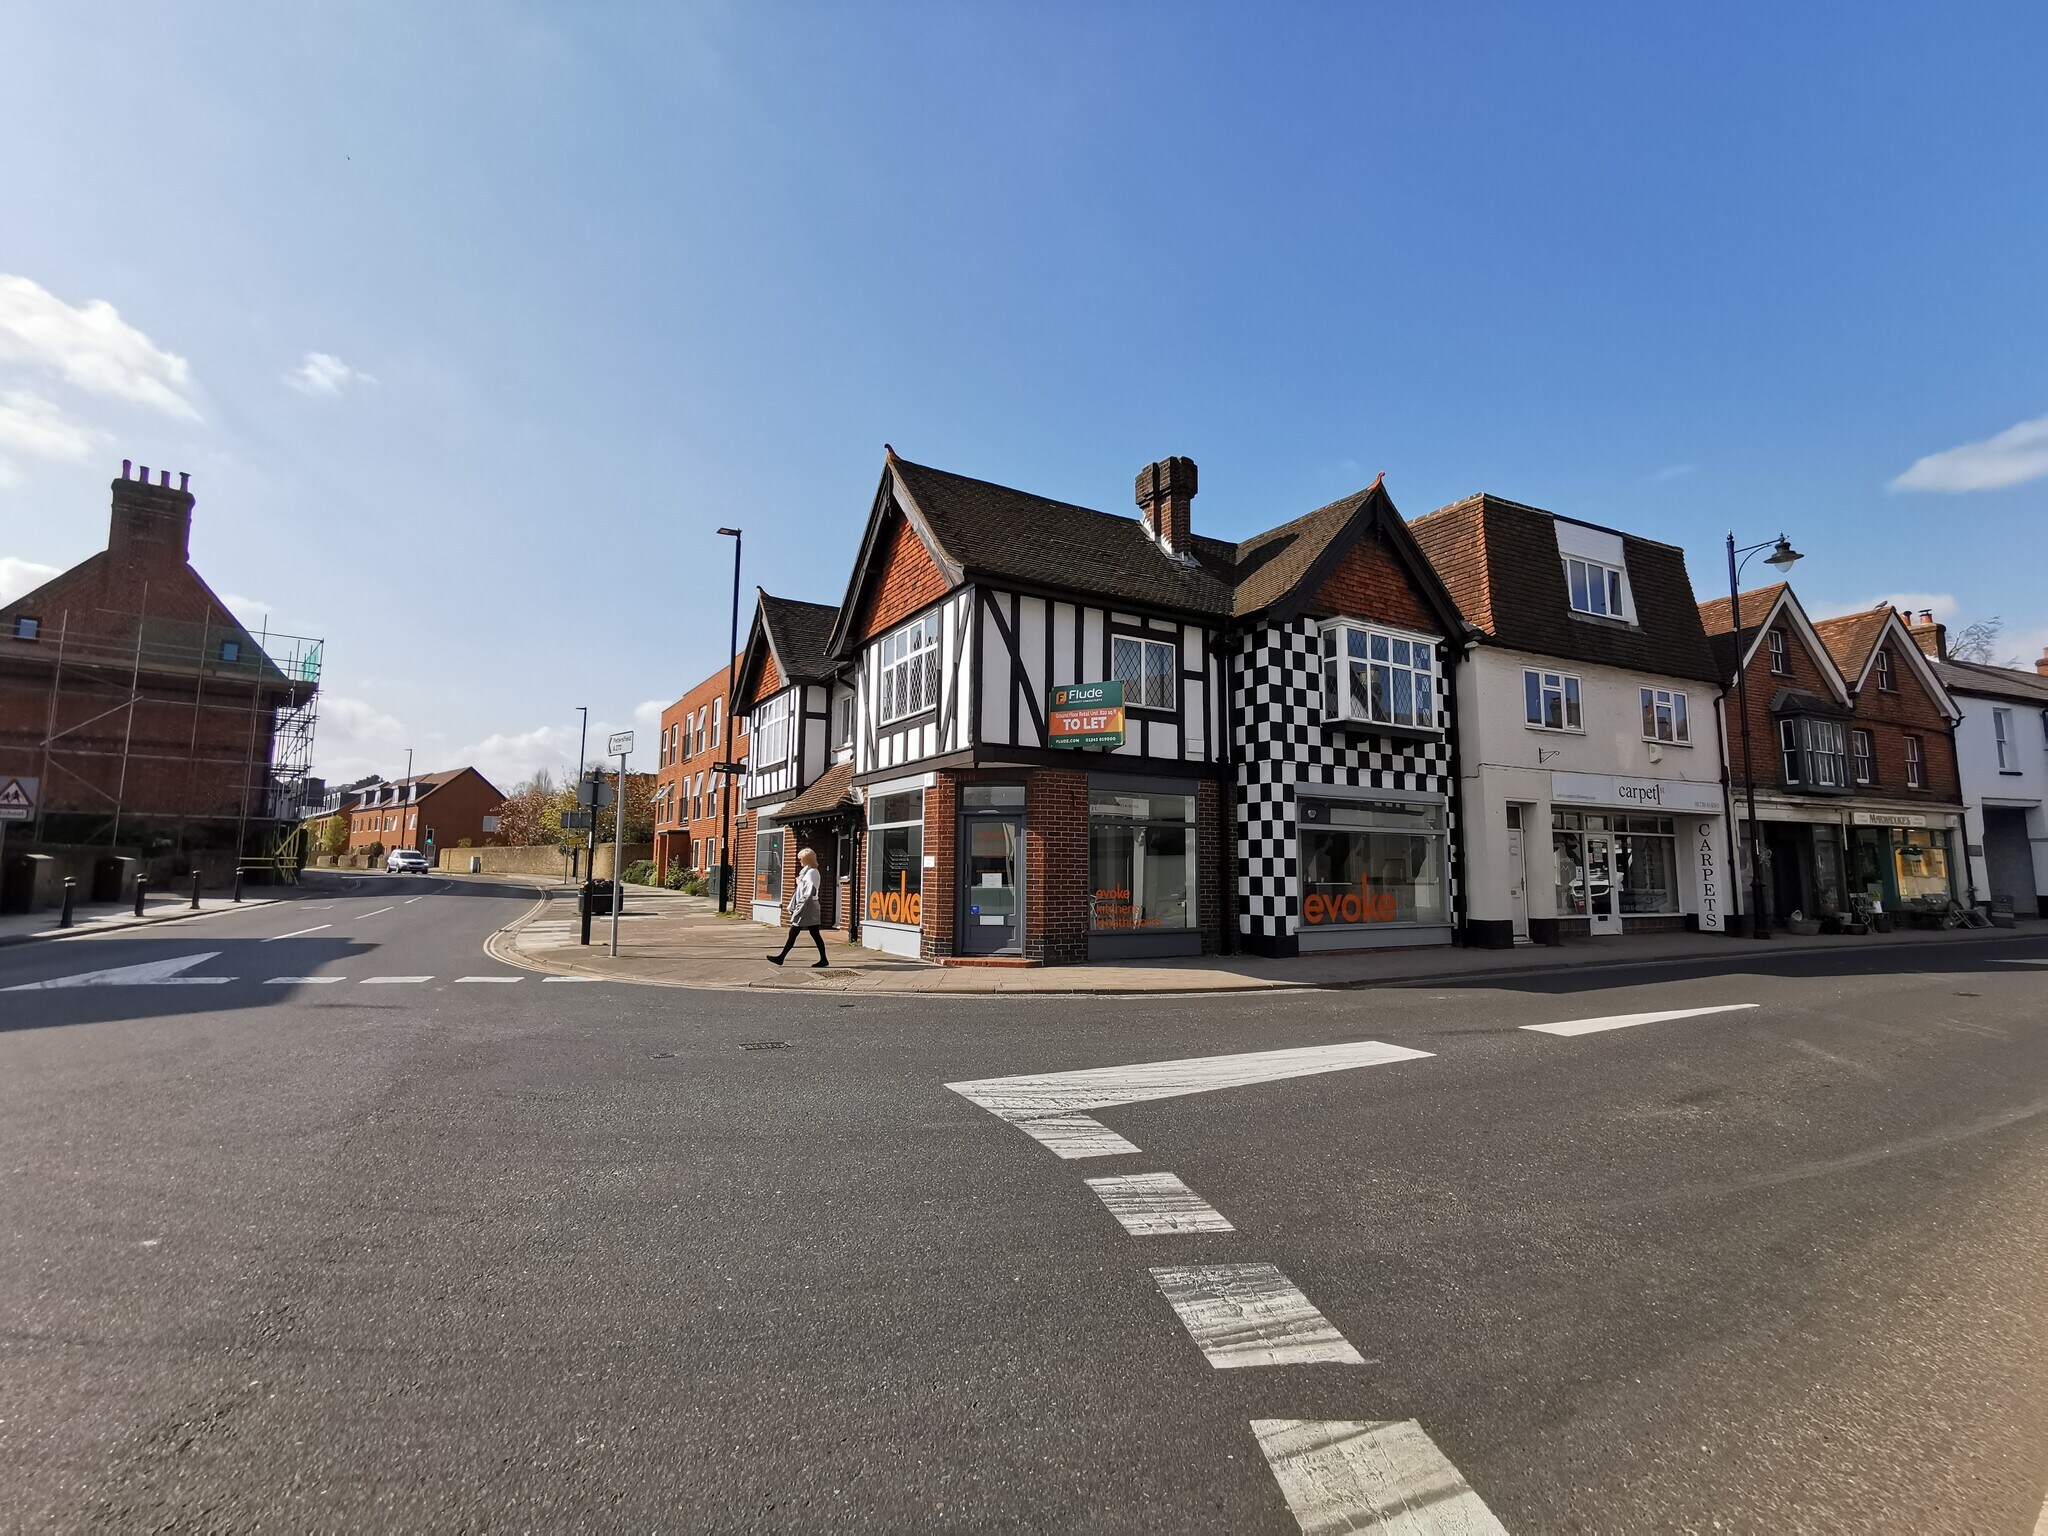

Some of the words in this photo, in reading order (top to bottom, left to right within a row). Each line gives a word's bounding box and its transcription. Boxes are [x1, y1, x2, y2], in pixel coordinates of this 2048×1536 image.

[1069, 688, 1103, 700] Flude
[1063, 718, 1081, 731] TO
[1083, 716, 1107, 730] LET
[1698, 823, 1717, 927] CARPETS
[869, 870, 921, 925] evoke
[1096, 882, 1131, 899] evoke
[1303, 871, 1397, 924] evoke
[1096, 903, 1140, 915] kitchens
